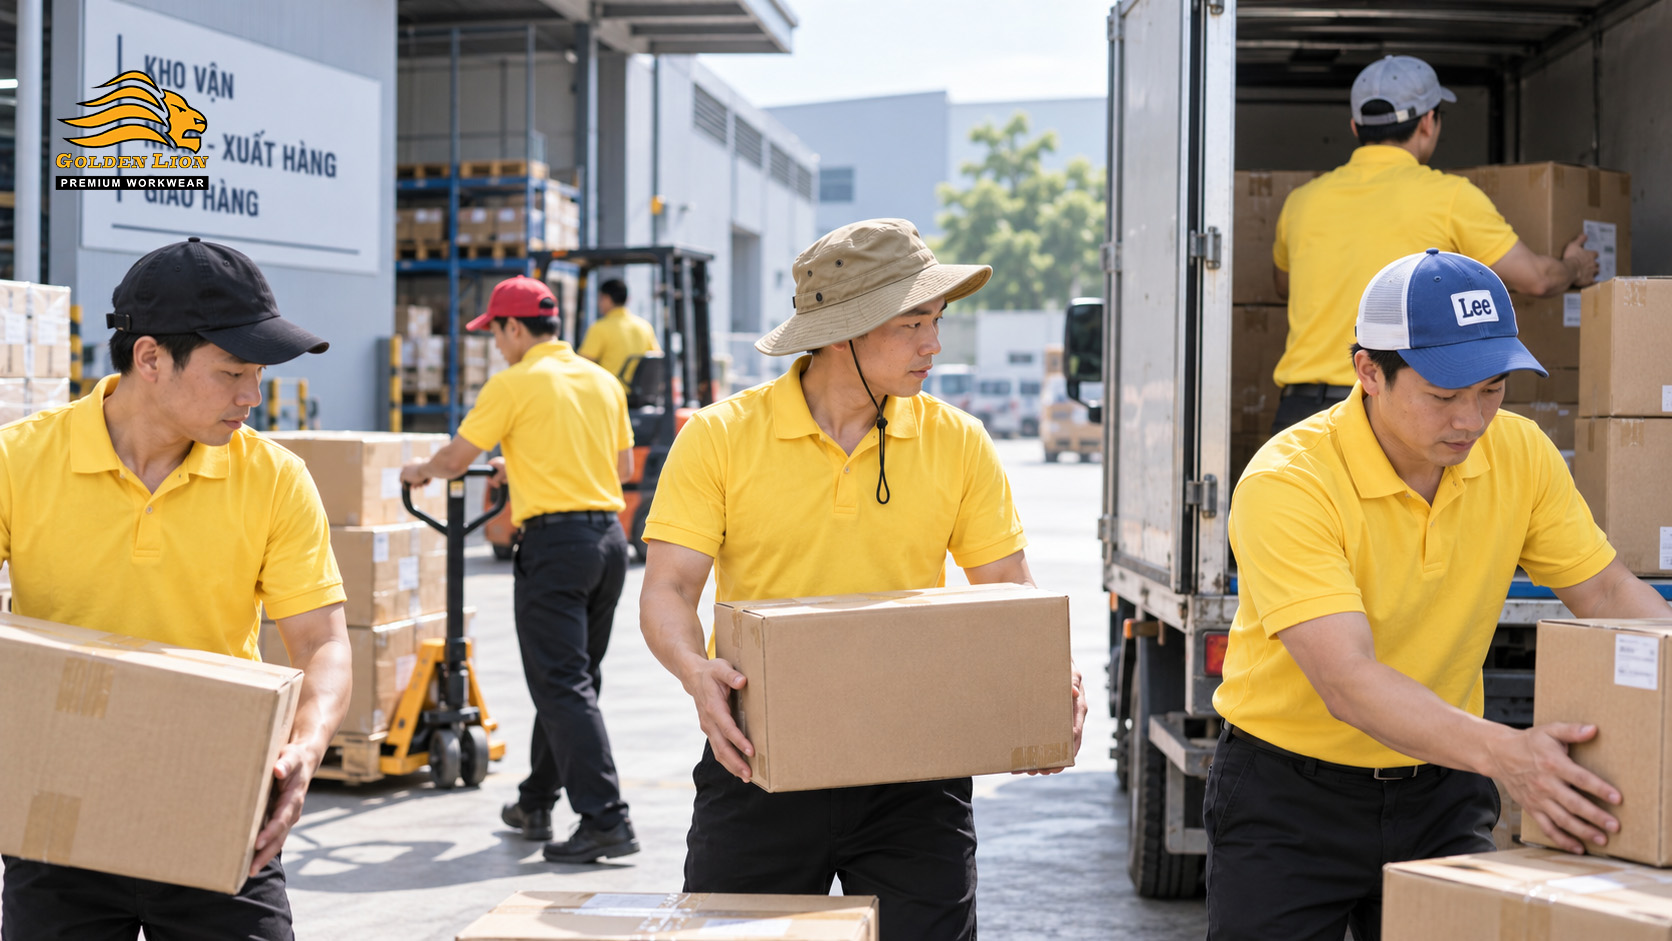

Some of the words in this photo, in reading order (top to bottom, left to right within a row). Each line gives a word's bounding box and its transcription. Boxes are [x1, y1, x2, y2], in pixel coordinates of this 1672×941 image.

[145, 54, 186, 90] KHO
[193, 62, 234, 103] VẬN
[222, 129, 276, 168] XUẤT
[282, 140, 337, 179] HÀNG
[202, 178, 259, 217] HÀNG
[1458, 298, 1492, 318] Lee
